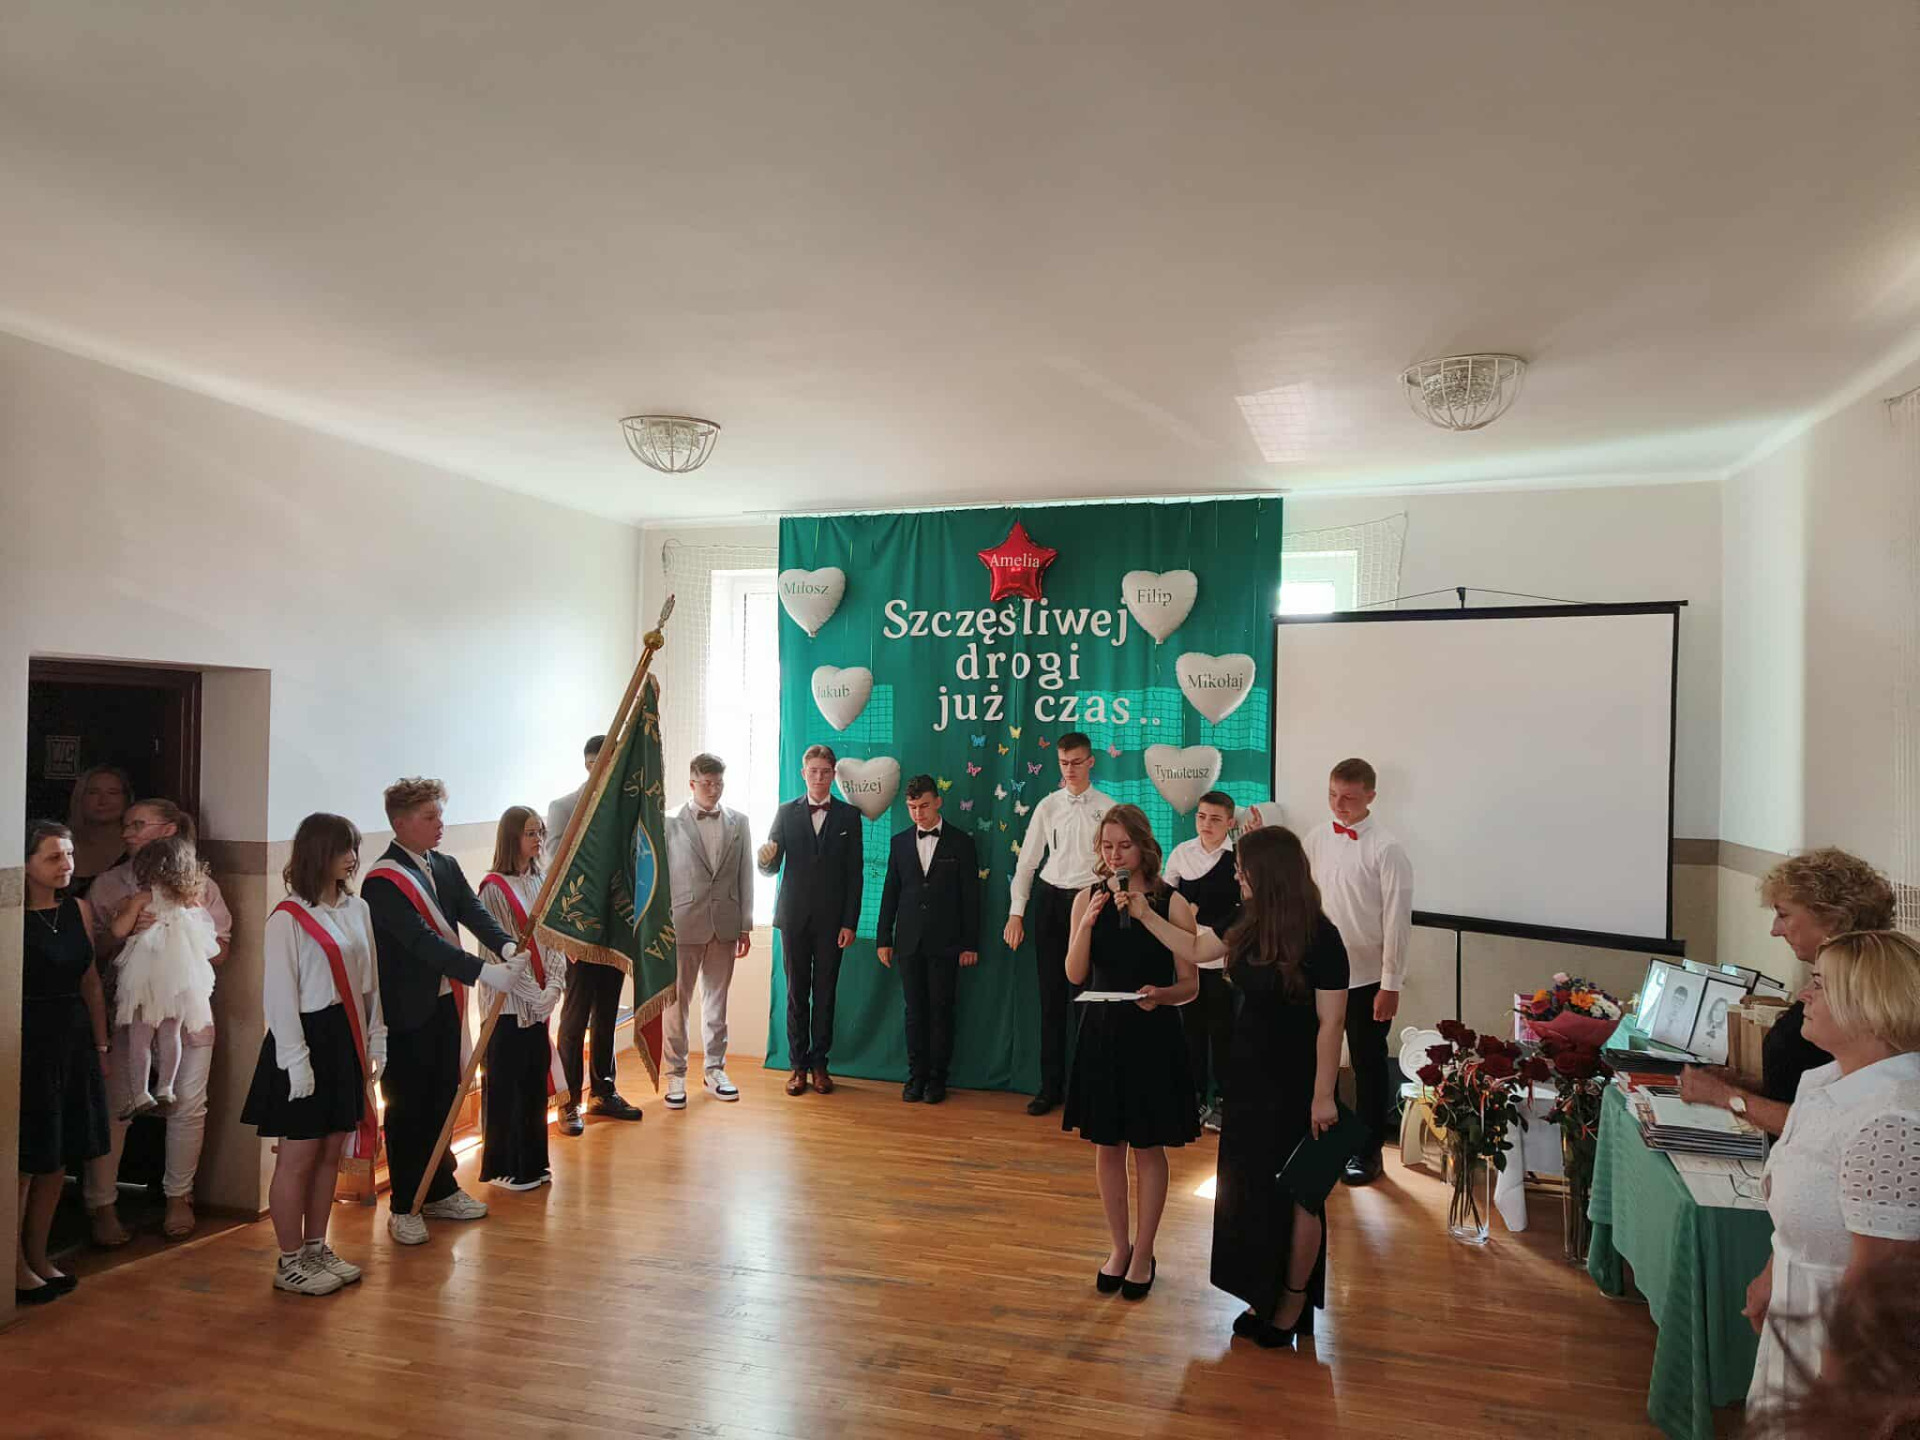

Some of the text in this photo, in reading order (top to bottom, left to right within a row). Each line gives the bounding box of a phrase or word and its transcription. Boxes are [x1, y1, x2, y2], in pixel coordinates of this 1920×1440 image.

[989, 552, 1040, 568] Amelia
[1138, 588, 1172, 607] Filip
[883, 598, 1128, 646] Szczęśliwej
[955, 643, 1081, 690] drogi
[1187, 672, 1243, 692] Mikołaj
[933, 684, 1004, 732] już
